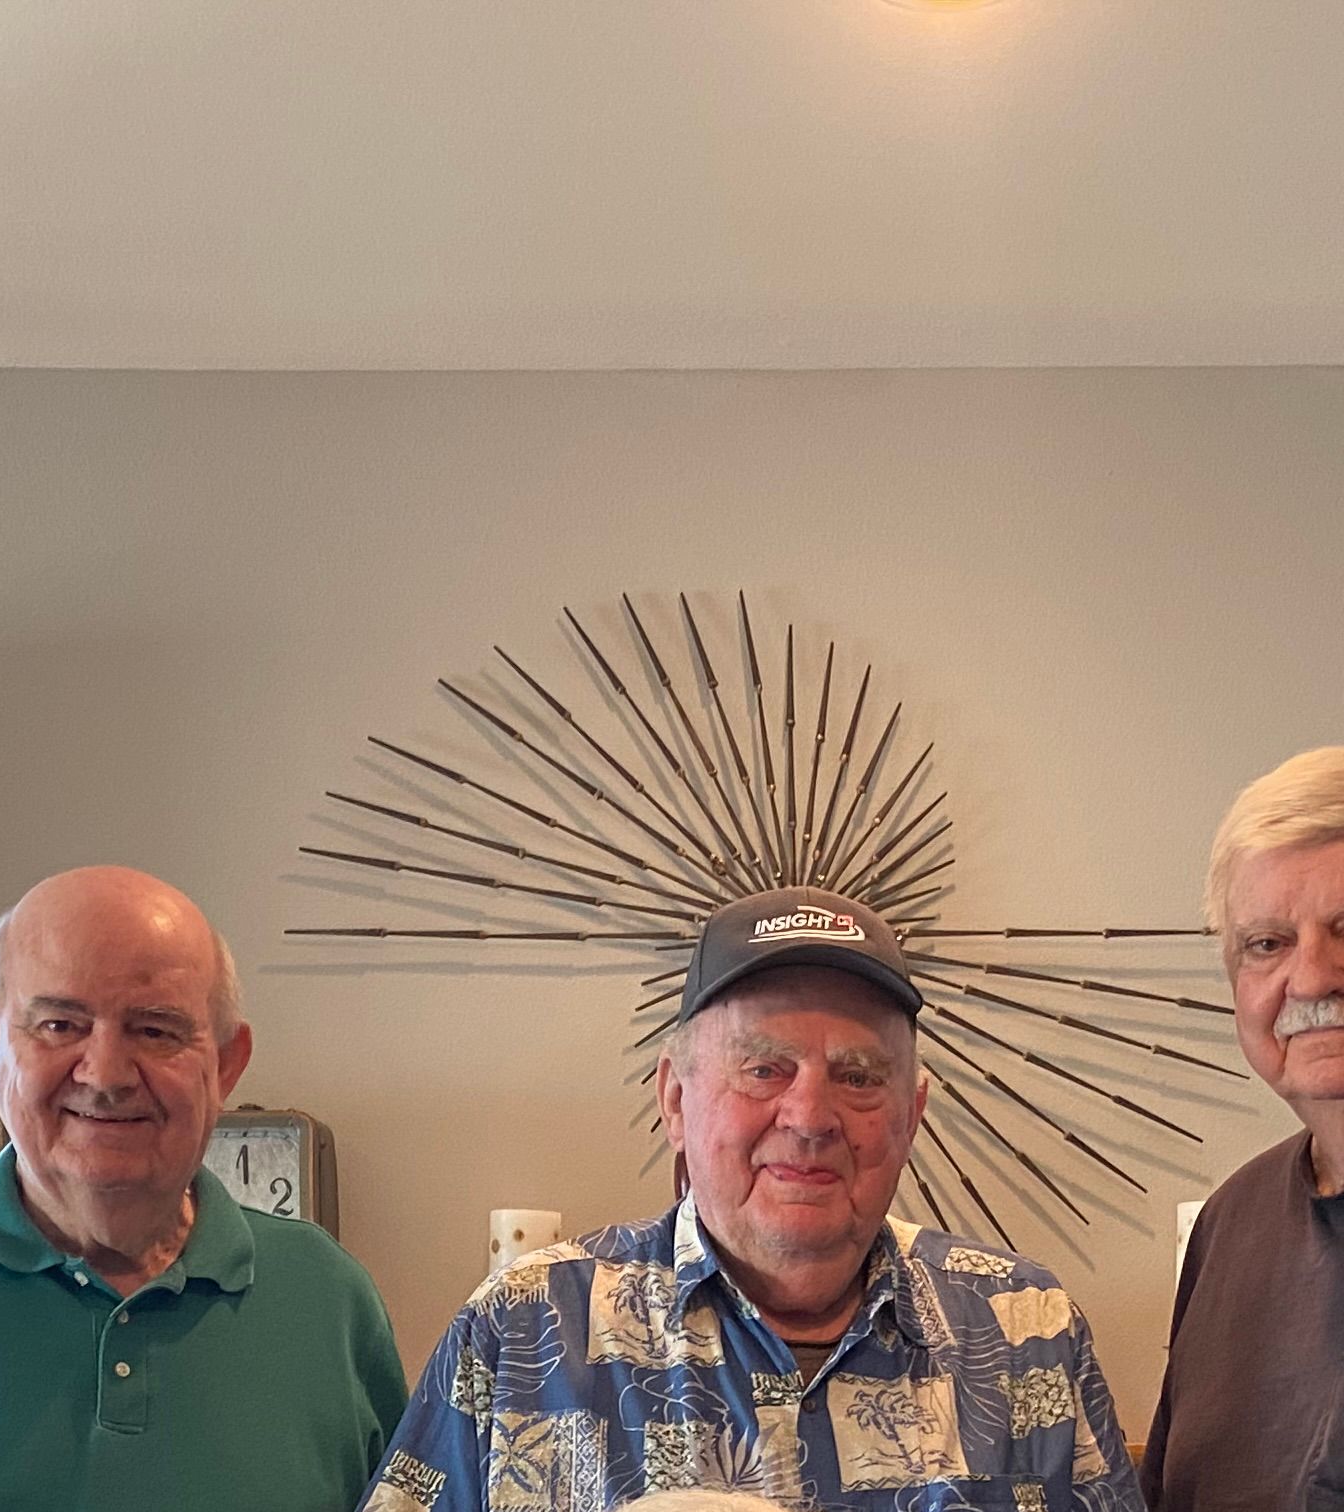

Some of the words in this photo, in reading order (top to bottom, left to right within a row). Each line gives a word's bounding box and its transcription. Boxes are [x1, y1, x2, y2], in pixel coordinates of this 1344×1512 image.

[754, 913, 833, 936] INSIGHT
[236, 1144, 249, 1185] 1
[269, 1177, 294, 1217] 2
